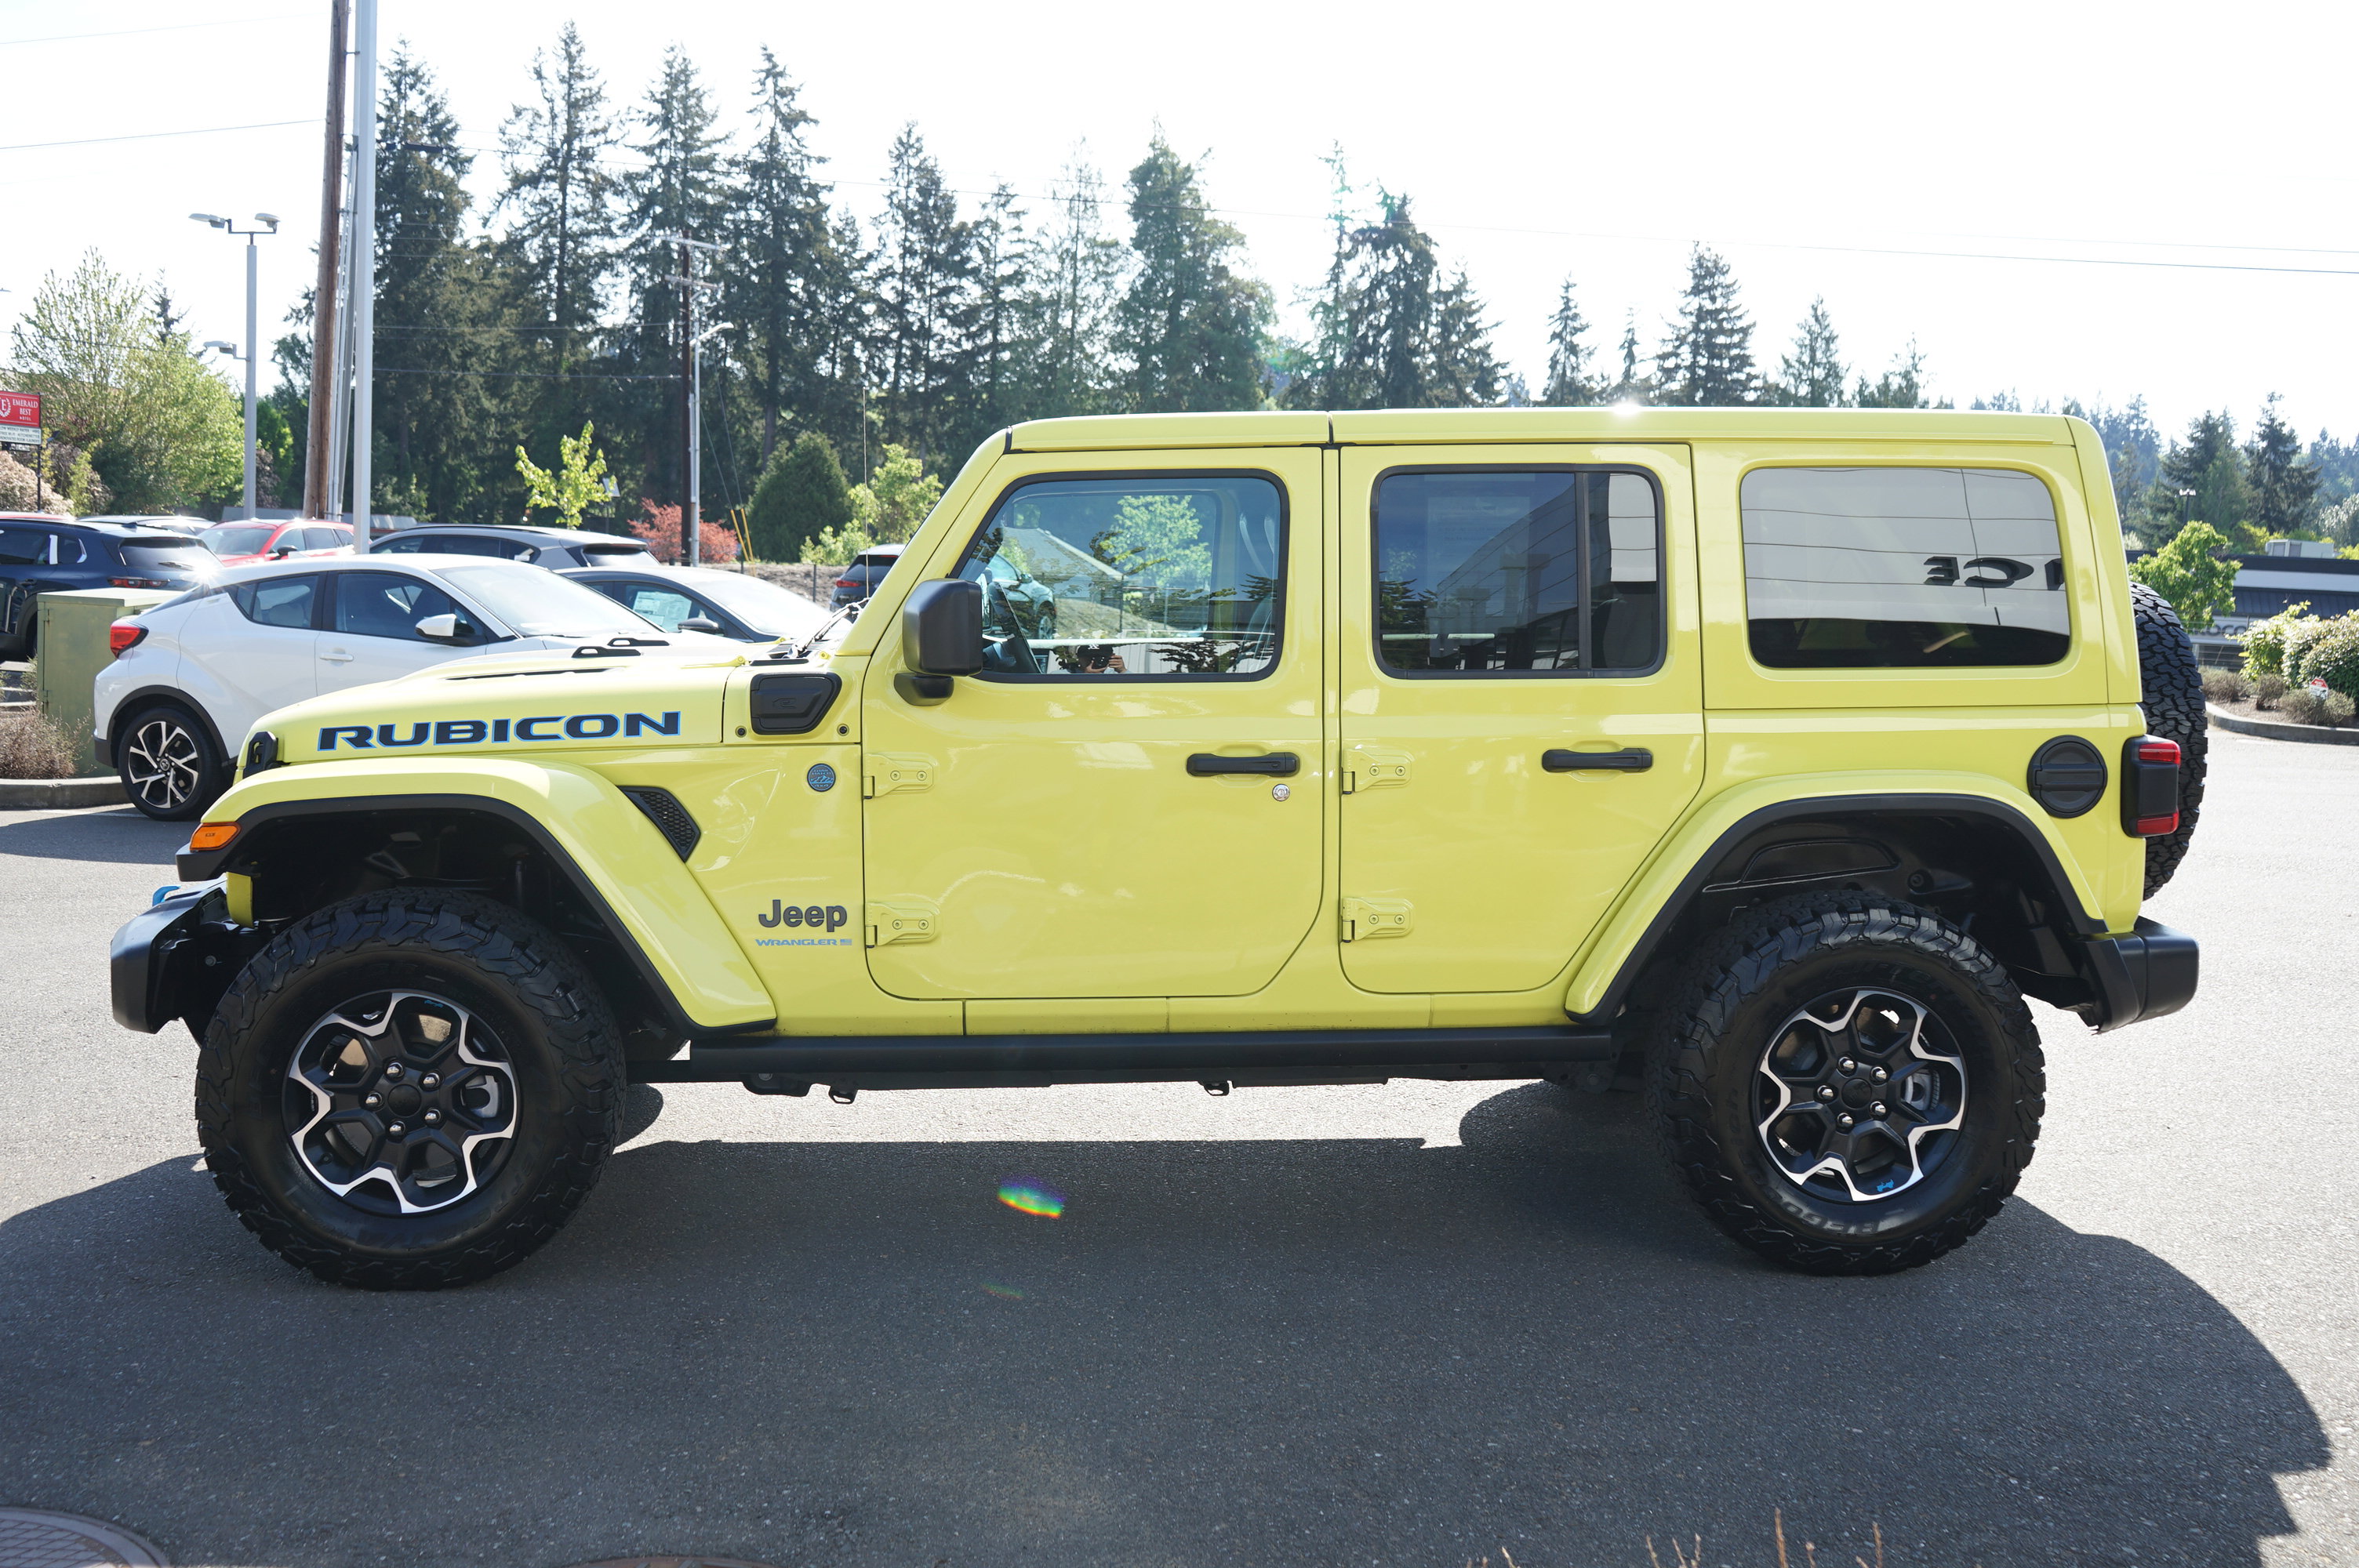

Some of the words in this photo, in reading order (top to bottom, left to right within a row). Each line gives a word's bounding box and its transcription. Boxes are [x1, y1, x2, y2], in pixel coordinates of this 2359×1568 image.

[13, 399, 38, 408] EMERALD
[317, 711, 681, 751] RUBICON
[758, 899, 847, 932] Jeep
